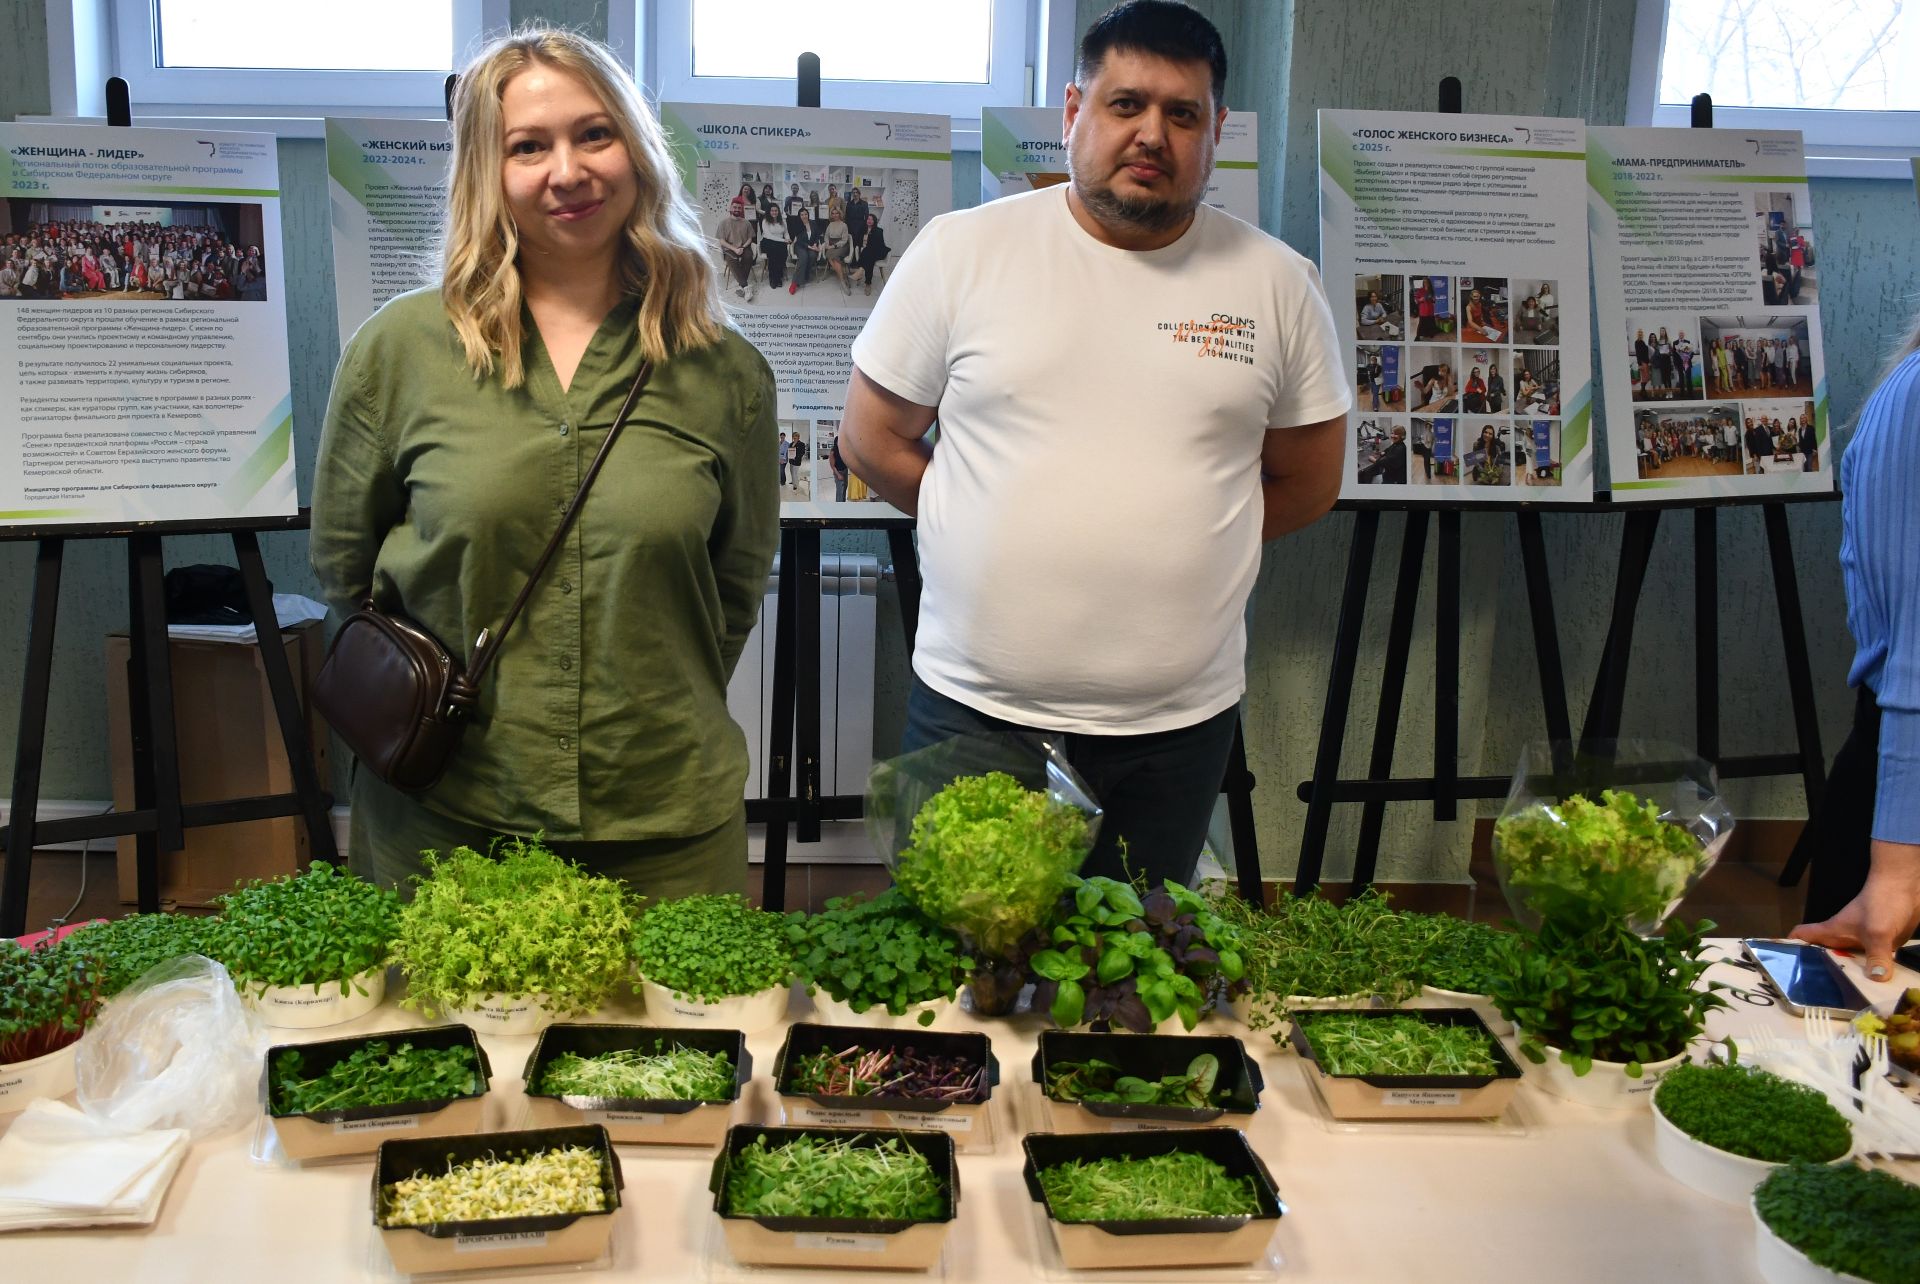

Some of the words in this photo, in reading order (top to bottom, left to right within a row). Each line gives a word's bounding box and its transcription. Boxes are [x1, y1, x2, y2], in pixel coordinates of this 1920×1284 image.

[696, 125, 747, 135] «ШКОЛА
[750, 126, 812, 137] СПИКЕРА»
[1352, 130, 1395, 140] «ГОЛОС
[1397, 131, 1457, 142] ЖЕНСКОГО
[1459, 133, 1514, 143] БИЗНЕСА»
[362, 140, 426, 150] «ЖЕНСКИЙ
[428, 141, 453, 151] БИЗ
[704, 140, 729, 150] 2025
[1015, 141, 1067, 150] «ВТОРНИ
[1359, 143, 1383, 152] 2025
[10, 146, 86, 159] «ЖЕНЩИНА
[96, 148, 144, 161] ЛИДЕР»
[1015, 155, 1021, 163] с
[1023, 154, 1046, 163] 2021
[363, 154, 416, 164] 2022-2024
[1611, 158, 1746, 169] «МАМА-ПРЕДПРИНИМАТЕЛЬ»
[13, 159, 80, 169] Региональный
[110, 162, 190, 174] образовательной
[192, 166, 243, 176] программы
[20, 169, 73, 180] Сибирском
[75, 170, 139, 181] Федеральном
[141, 173, 172, 182] округе
[1613, 172, 1656, 180] 2018-2022
[12, 180, 39, 190] 2023
[174, 307, 214, 315] Сибирского
[17, 316, 69, 324] Федерального
[124, 316, 158, 324] обучение
[190, 316, 239, 324] региональной
[790, 313, 849, 323] образовательный
[1211, 313, 1256, 330] COLIN'S
[17, 325, 80, 333] образовательной
[123, 325, 187, 333] «Женщина-лидер».
[756, 321, 789, 331] обучение
[790, 324, 827, 332] участников
[1157, 322, 1210, 332] COLLECTION
[1236, 329, 1255, 340] WITH
[18, 334, 50, 342] сентябрь
[748, 331, 792, 340] эффективной
[793, 333, 836, 341] презентации
[769, 341, 807, 349] участникам
[808, 342, 848, 350] преодолеть
[1191, 335, 1212, 344] BEST
[1214, 338, 1254, 352] QUALITIES
[791, 351, 825, 359] научиться
[1219, 351, 1238, 362] HAVE
[1240, 355, 1254, 365] FUN
[797, 361, 834, 369] аудитории.
[803, 368, 825, 377] бренд,
[792, 387, 829, 395] площадках.
[793, 402, 834, 412] Руководитель
[53, 440, 107, 449] президентской
[108, 439, 149, 448] платформы
[23, 449, 78, 457] возможностей»
[24, 468, 71, 477] Кемеровской
[24, 484, 60, 494] Инициатор
[61, 485, 98, 493] программы
[99, 484, 111, 492] для
[112, 482, 149, 491] Сибирского
[150, 481, 195, 490] федерального
